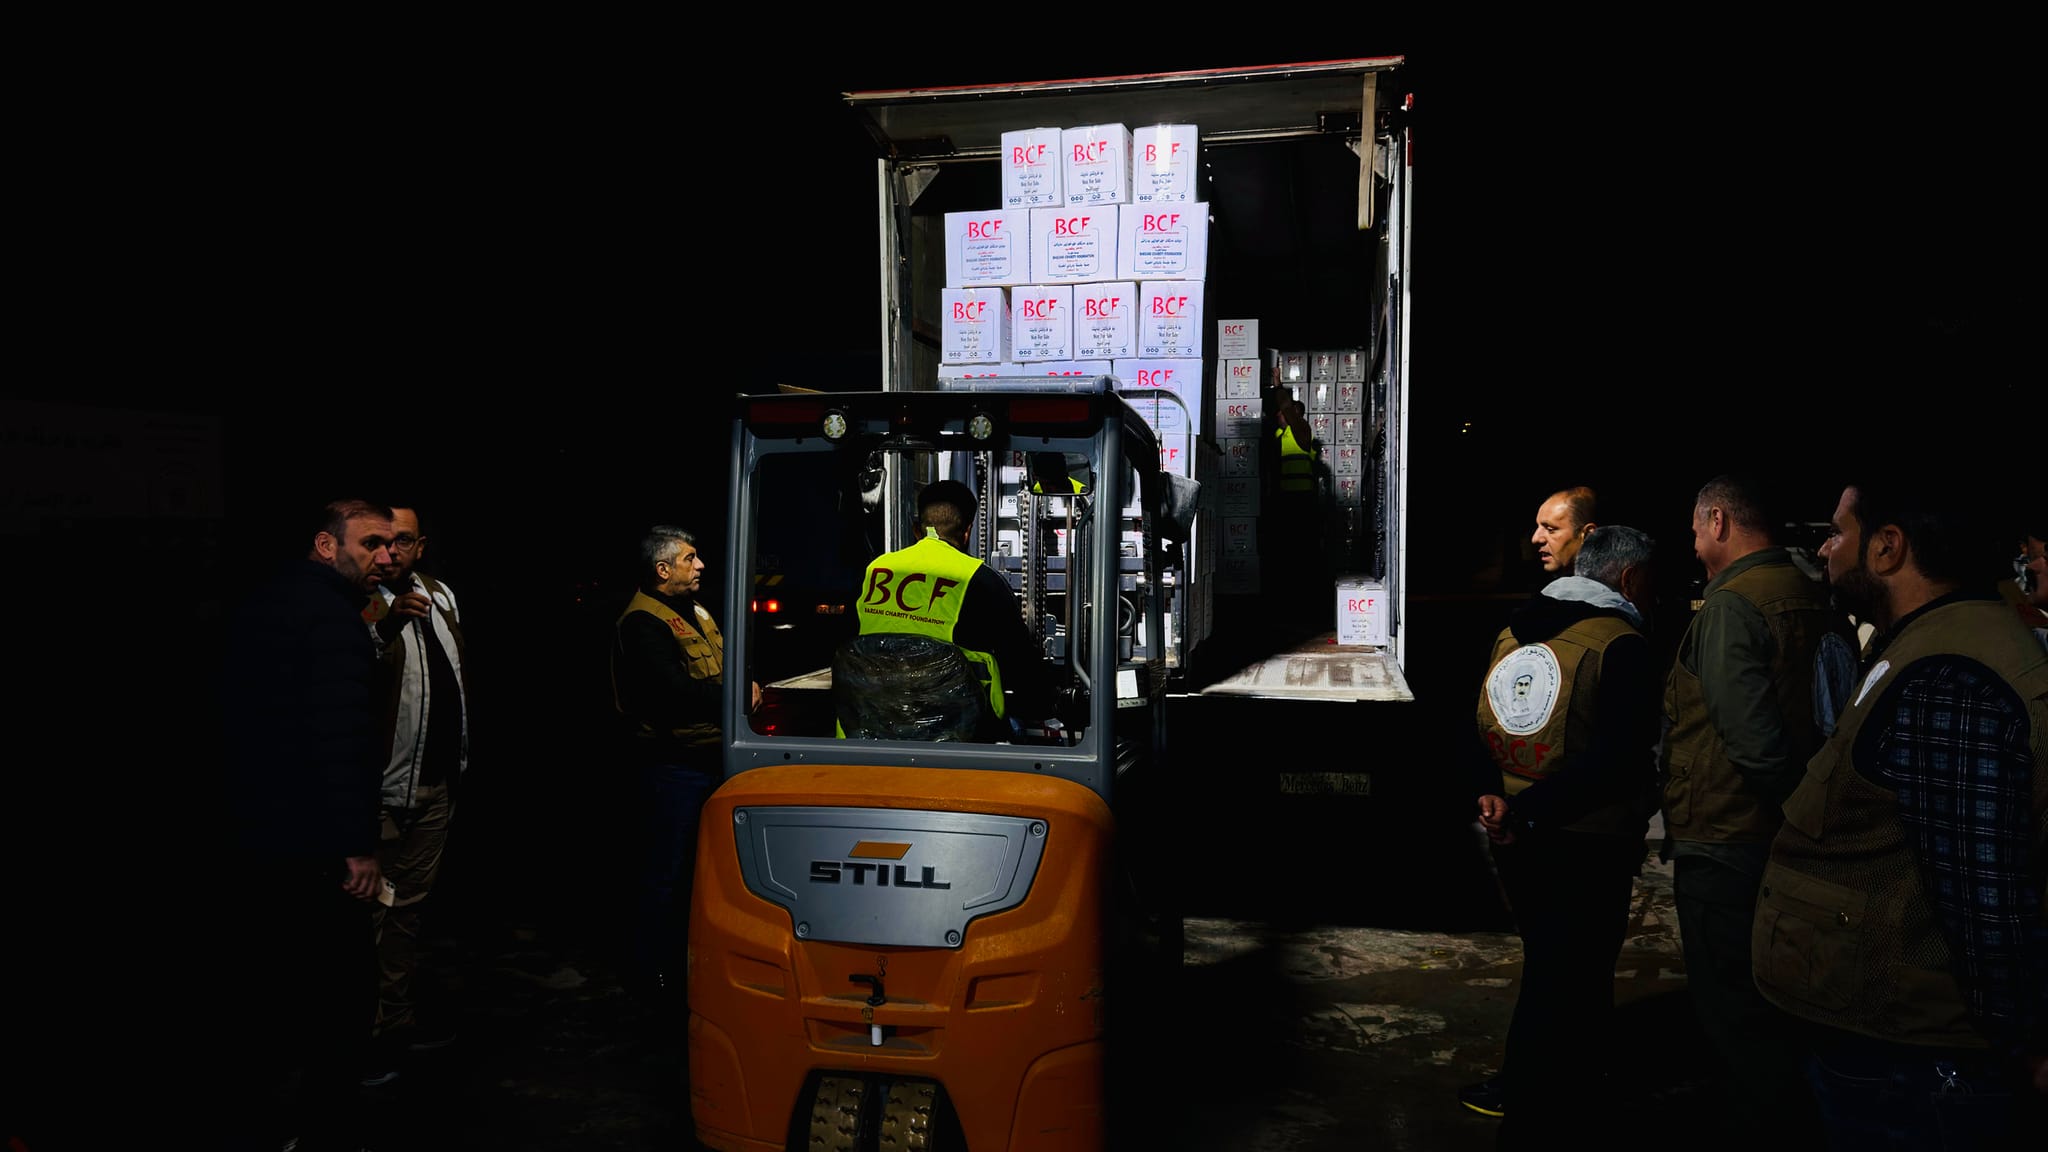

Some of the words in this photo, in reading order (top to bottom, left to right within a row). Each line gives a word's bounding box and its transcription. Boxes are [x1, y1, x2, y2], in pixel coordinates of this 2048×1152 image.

[1013, 144, 1046, 163] BCF
[1074, 141, 1107, 161] BCF
[1146, 143, 1180, 161] BF
[968, 220, 1003, 238] BCF
[1055, 217, 1090, 234] BCF
[1143, 214, 1180, 231] BCF
[953, 302, 986, 319] BCF
[1024, 299, 1057, 317] BCF
[1085, 298, 1120, 316] BCF
[1152, 296, 1187, 314] BCF
[1224, 325, 1244, 335] BCF
[1344, 355, 1360, 363] BF
[1137, 369, 1173, 387] BCF
[1233, 366, 1252, 376] BCF
[864, 567, 959, 612] BCF
[1348, 599, 1374, 612] BCF
[885, 610, 908, 619] CHARITY
[909, 614, 945, 625] FOUNDATION
[1487, 732, 1551, 768] BCF
[809, 861, 951, 890] STILL
